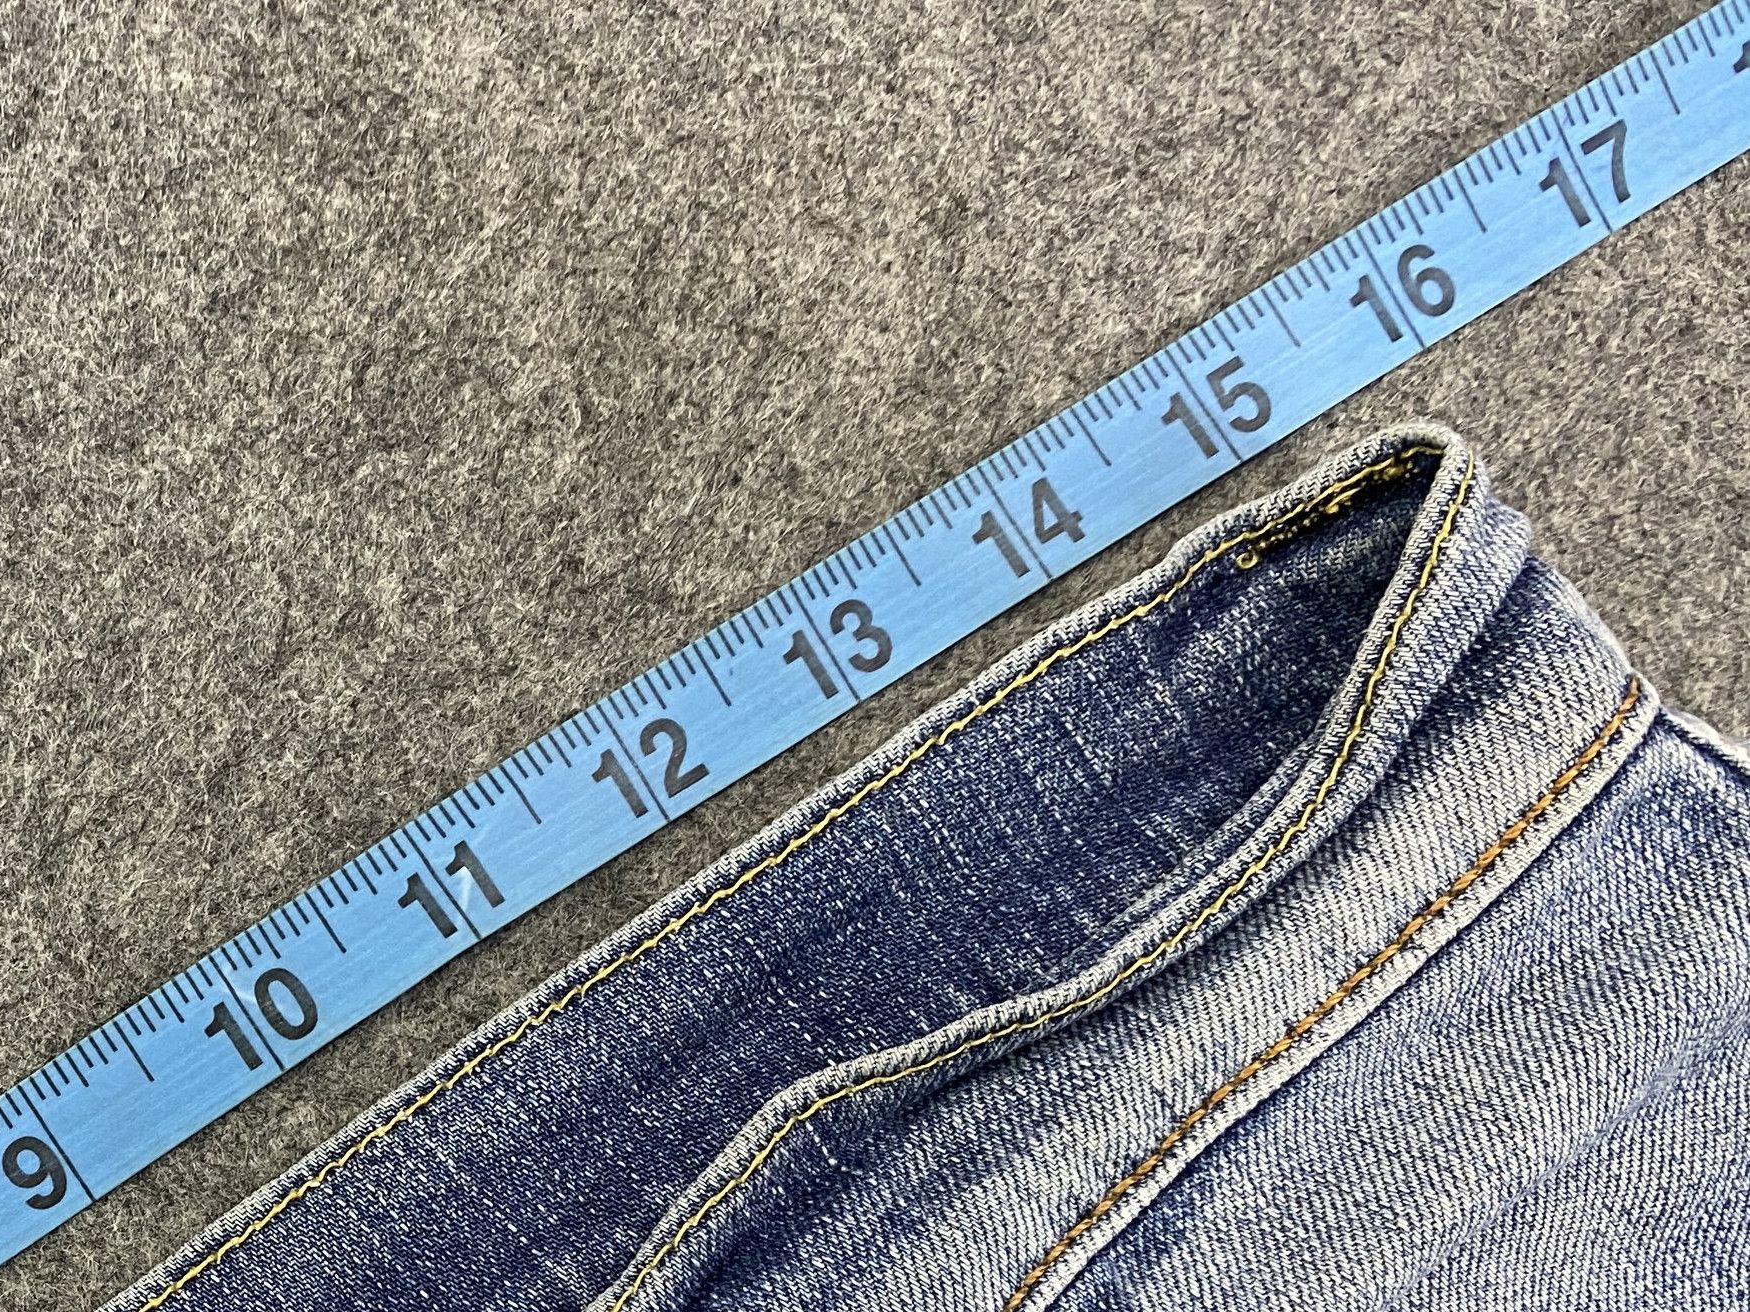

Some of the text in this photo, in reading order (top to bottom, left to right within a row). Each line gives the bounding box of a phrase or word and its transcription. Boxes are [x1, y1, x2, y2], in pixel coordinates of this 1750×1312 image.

[1539, 119, 1630, 227] 17
[1351, 244, 1455, 342] 16
[1161, 355, 1272, 460] 15
[971, 477, 1085, 579] 14
[782, 599, 893, 700] 13
[591, 718, 710, 818] 12
[398, 840, 505, 939] 11
[204, 967, 318, 1071] 10
[1, 1136, 67, 1210] 9
